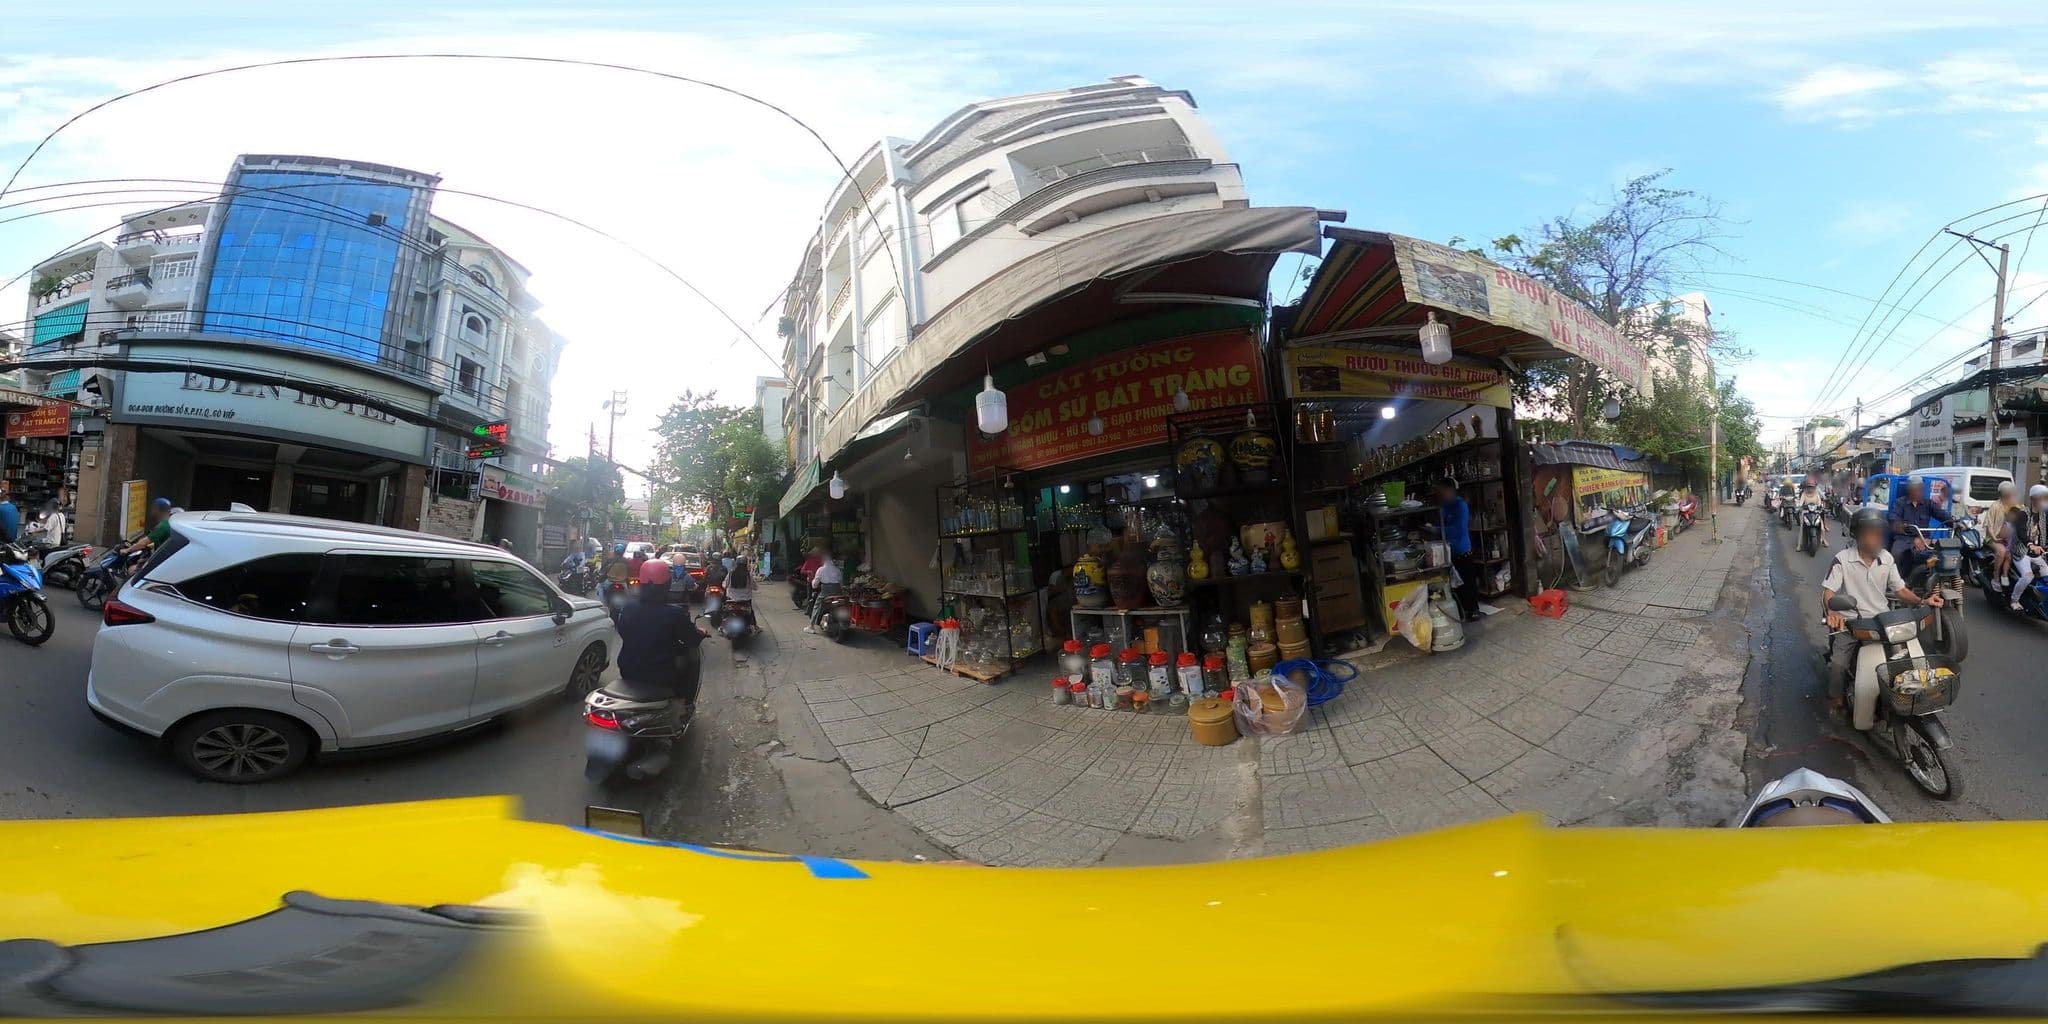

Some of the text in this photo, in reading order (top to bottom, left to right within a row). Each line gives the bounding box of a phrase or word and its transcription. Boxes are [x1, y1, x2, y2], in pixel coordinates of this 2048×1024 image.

[1495, 268, 1550, 306] RƯỢU
[1039, 347, 1194, 400] CÁT TƯỜNG
[1345, 354, 1388, 373] RƯỢU
[1442, 365, 1462, 380] GIA
[1008, 364, 1251, 437] GỐM SỨ BÁT TRÀNG
[1135, 403, 1174, 422] PHONG
